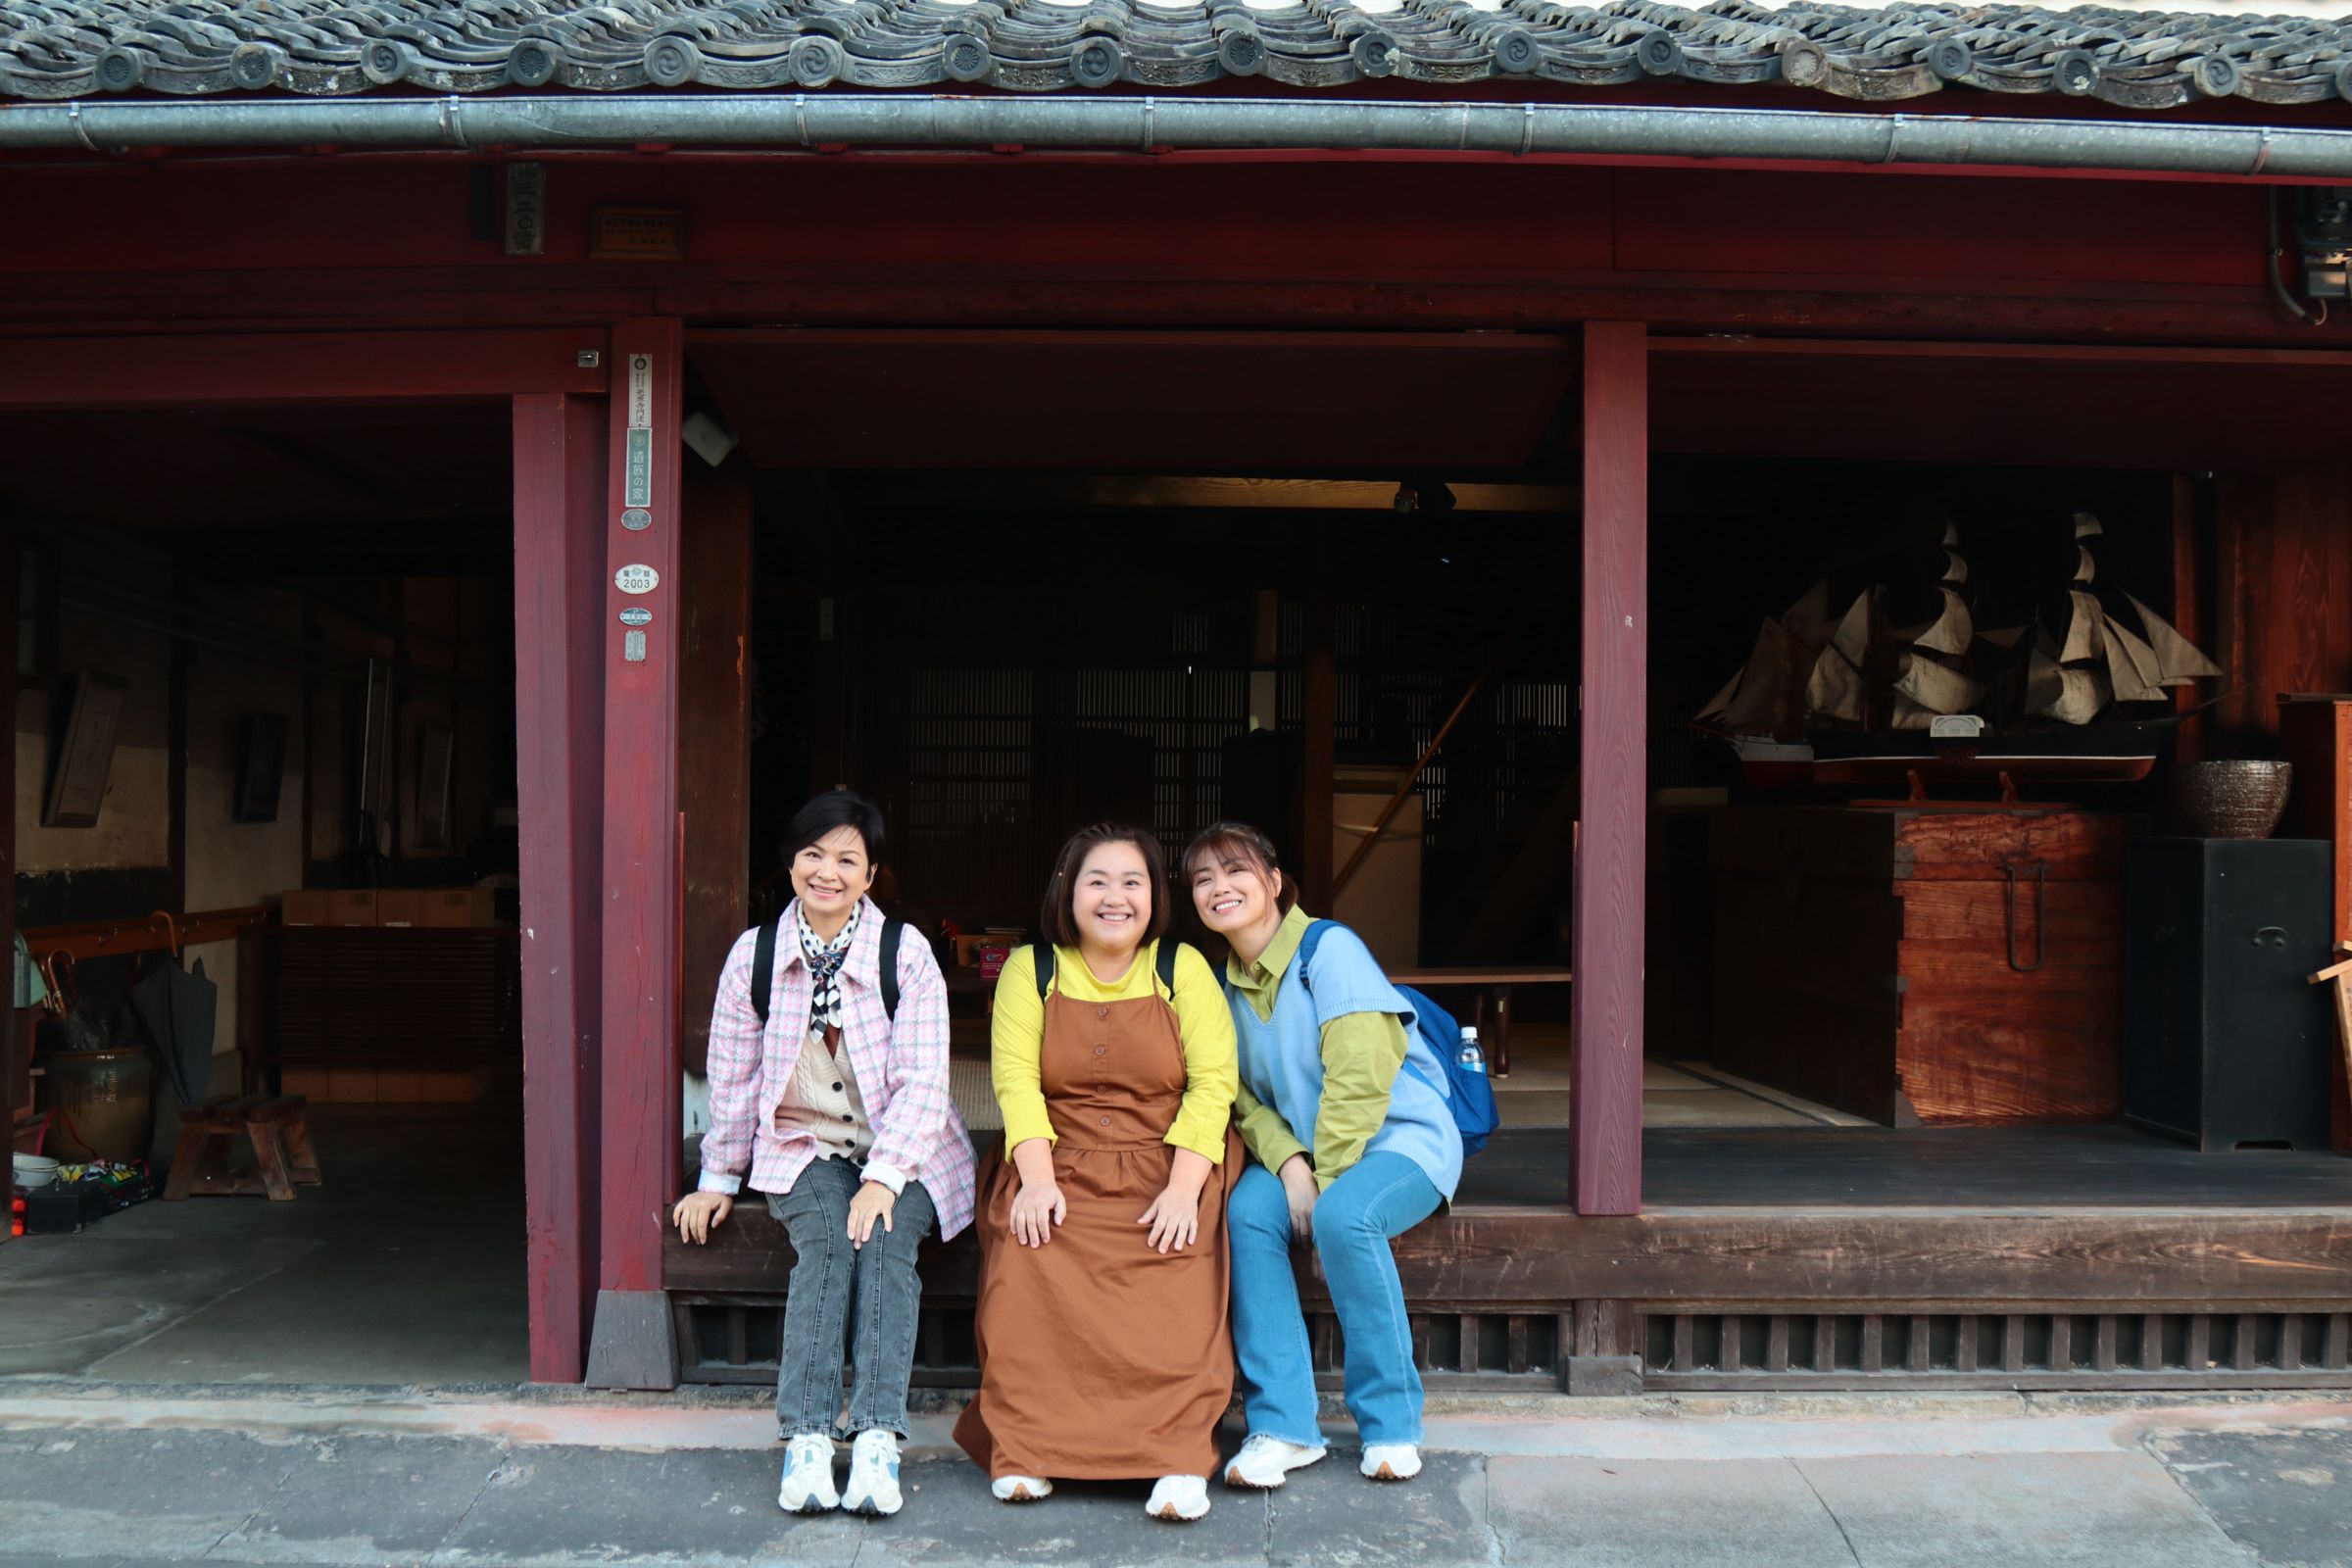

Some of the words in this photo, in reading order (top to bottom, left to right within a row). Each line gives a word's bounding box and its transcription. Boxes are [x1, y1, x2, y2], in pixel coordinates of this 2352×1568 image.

[633, 450, 644, 501] 遺族の家
[623, 578, 651, 589] 2003
